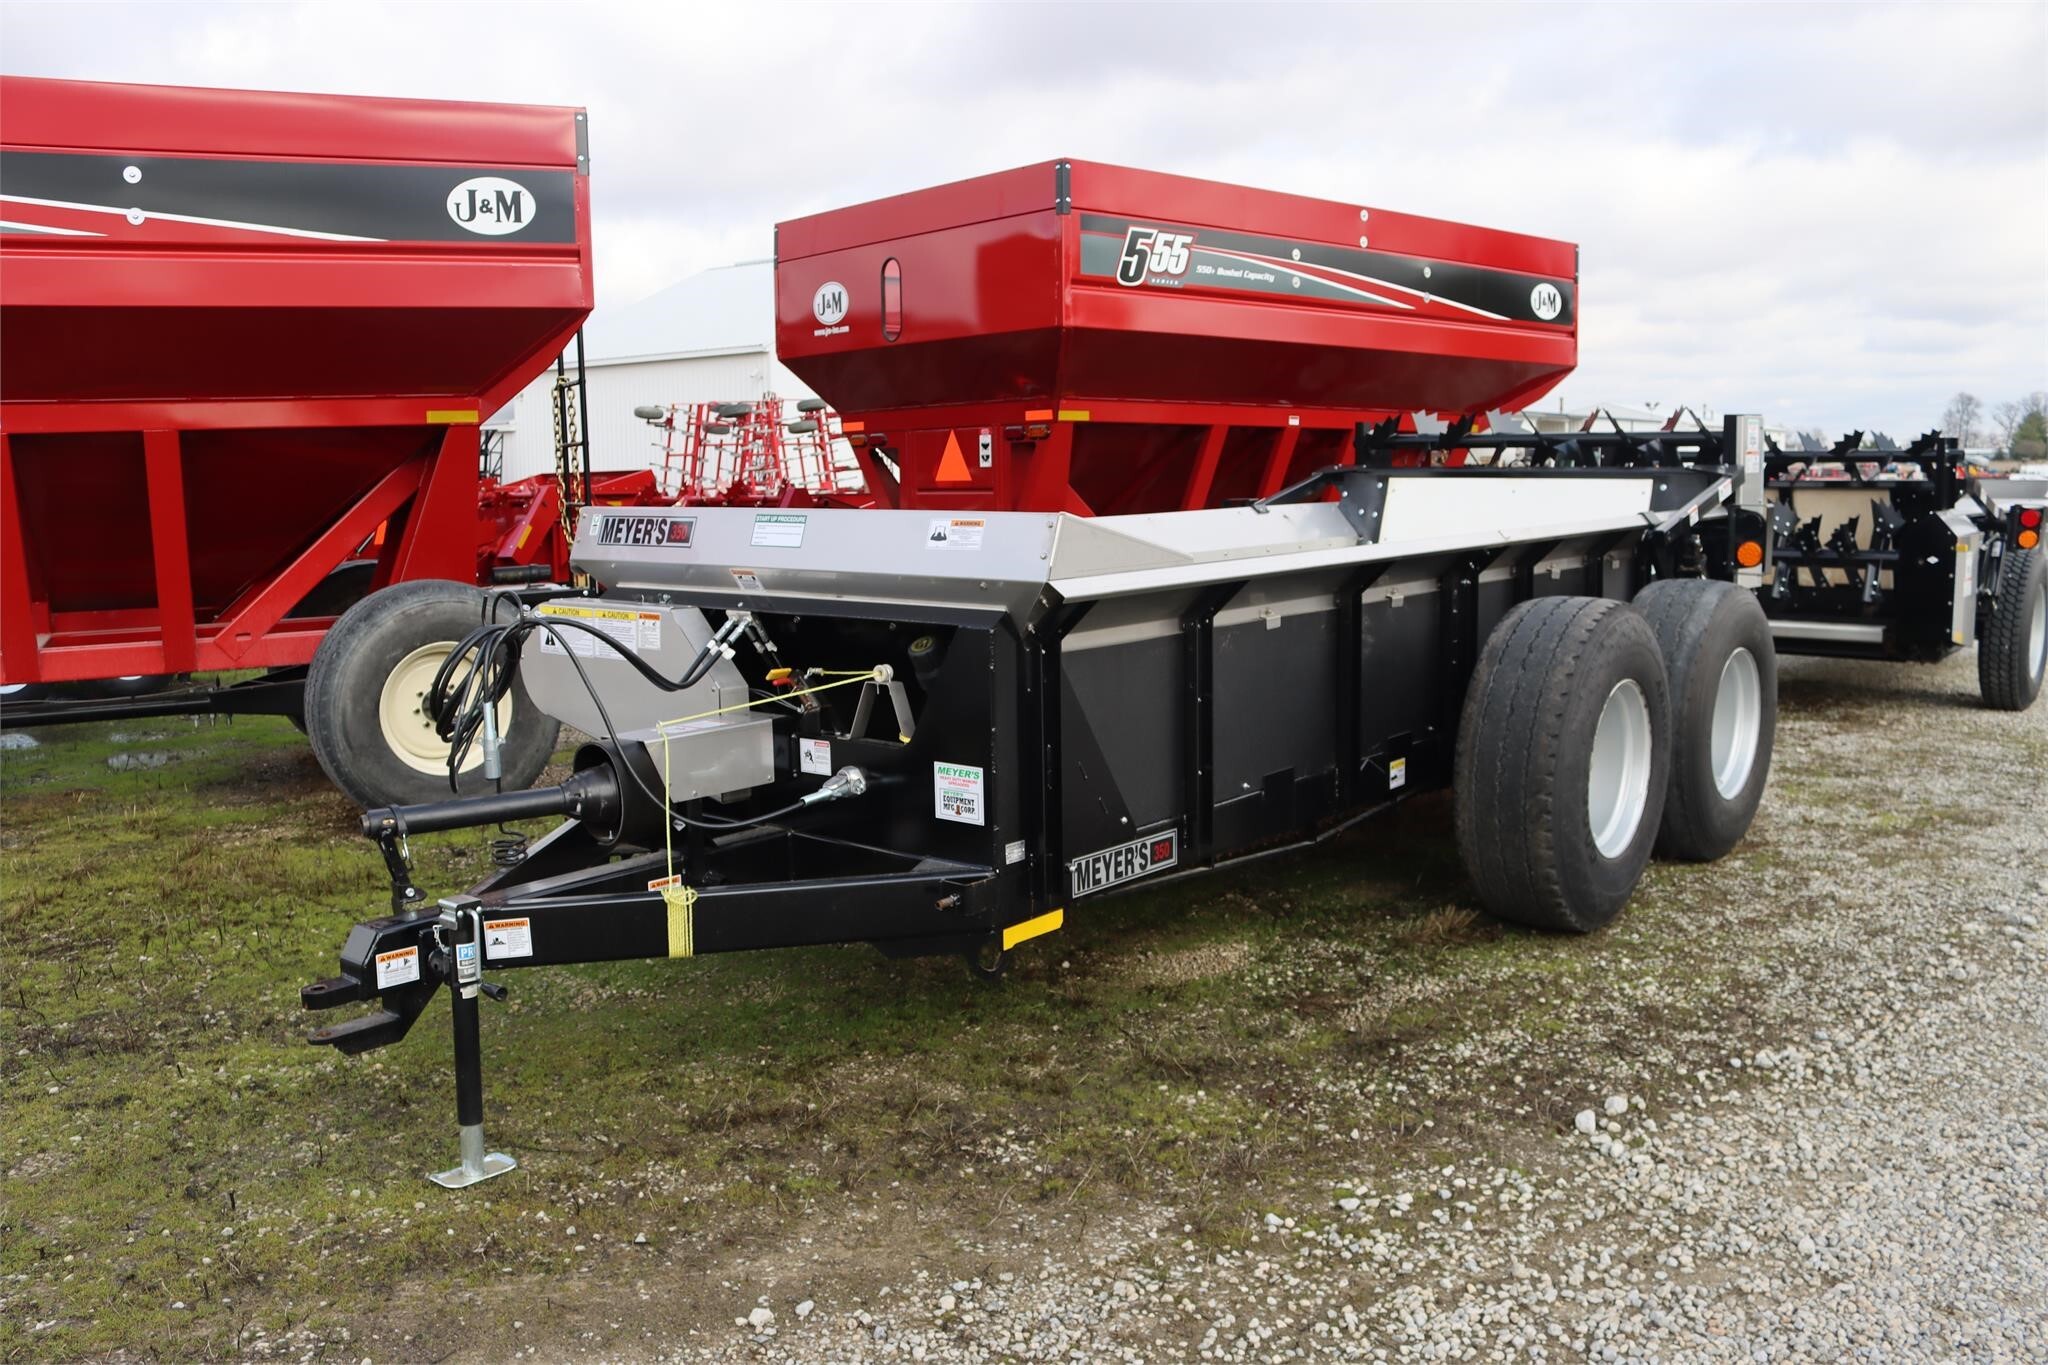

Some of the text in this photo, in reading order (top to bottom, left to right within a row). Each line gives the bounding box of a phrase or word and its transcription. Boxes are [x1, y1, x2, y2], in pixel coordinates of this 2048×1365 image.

[454, 189, 522, 223] J&M
[1116, 226, 1194, 287] 555
[1243, 271, 1276, 283] Capacity
[817, 291, 842, 316] J&M
[1533, 290, 1556, 313] J&M
[601, 518, 688, 544] MEYER'S 350
[559, 607, 580, 617] CAUTION
[607, 610, 630, 620] CAUTION
[938, 767, 980, 780] MEYER'S
[943, 795, 974, 806] EQUIPMENT
[1077, 842, 1170, 892] MEYER'S 350
[495, 921, 526, 929] WARNING
[386, 951, 414, 960] WARNING
